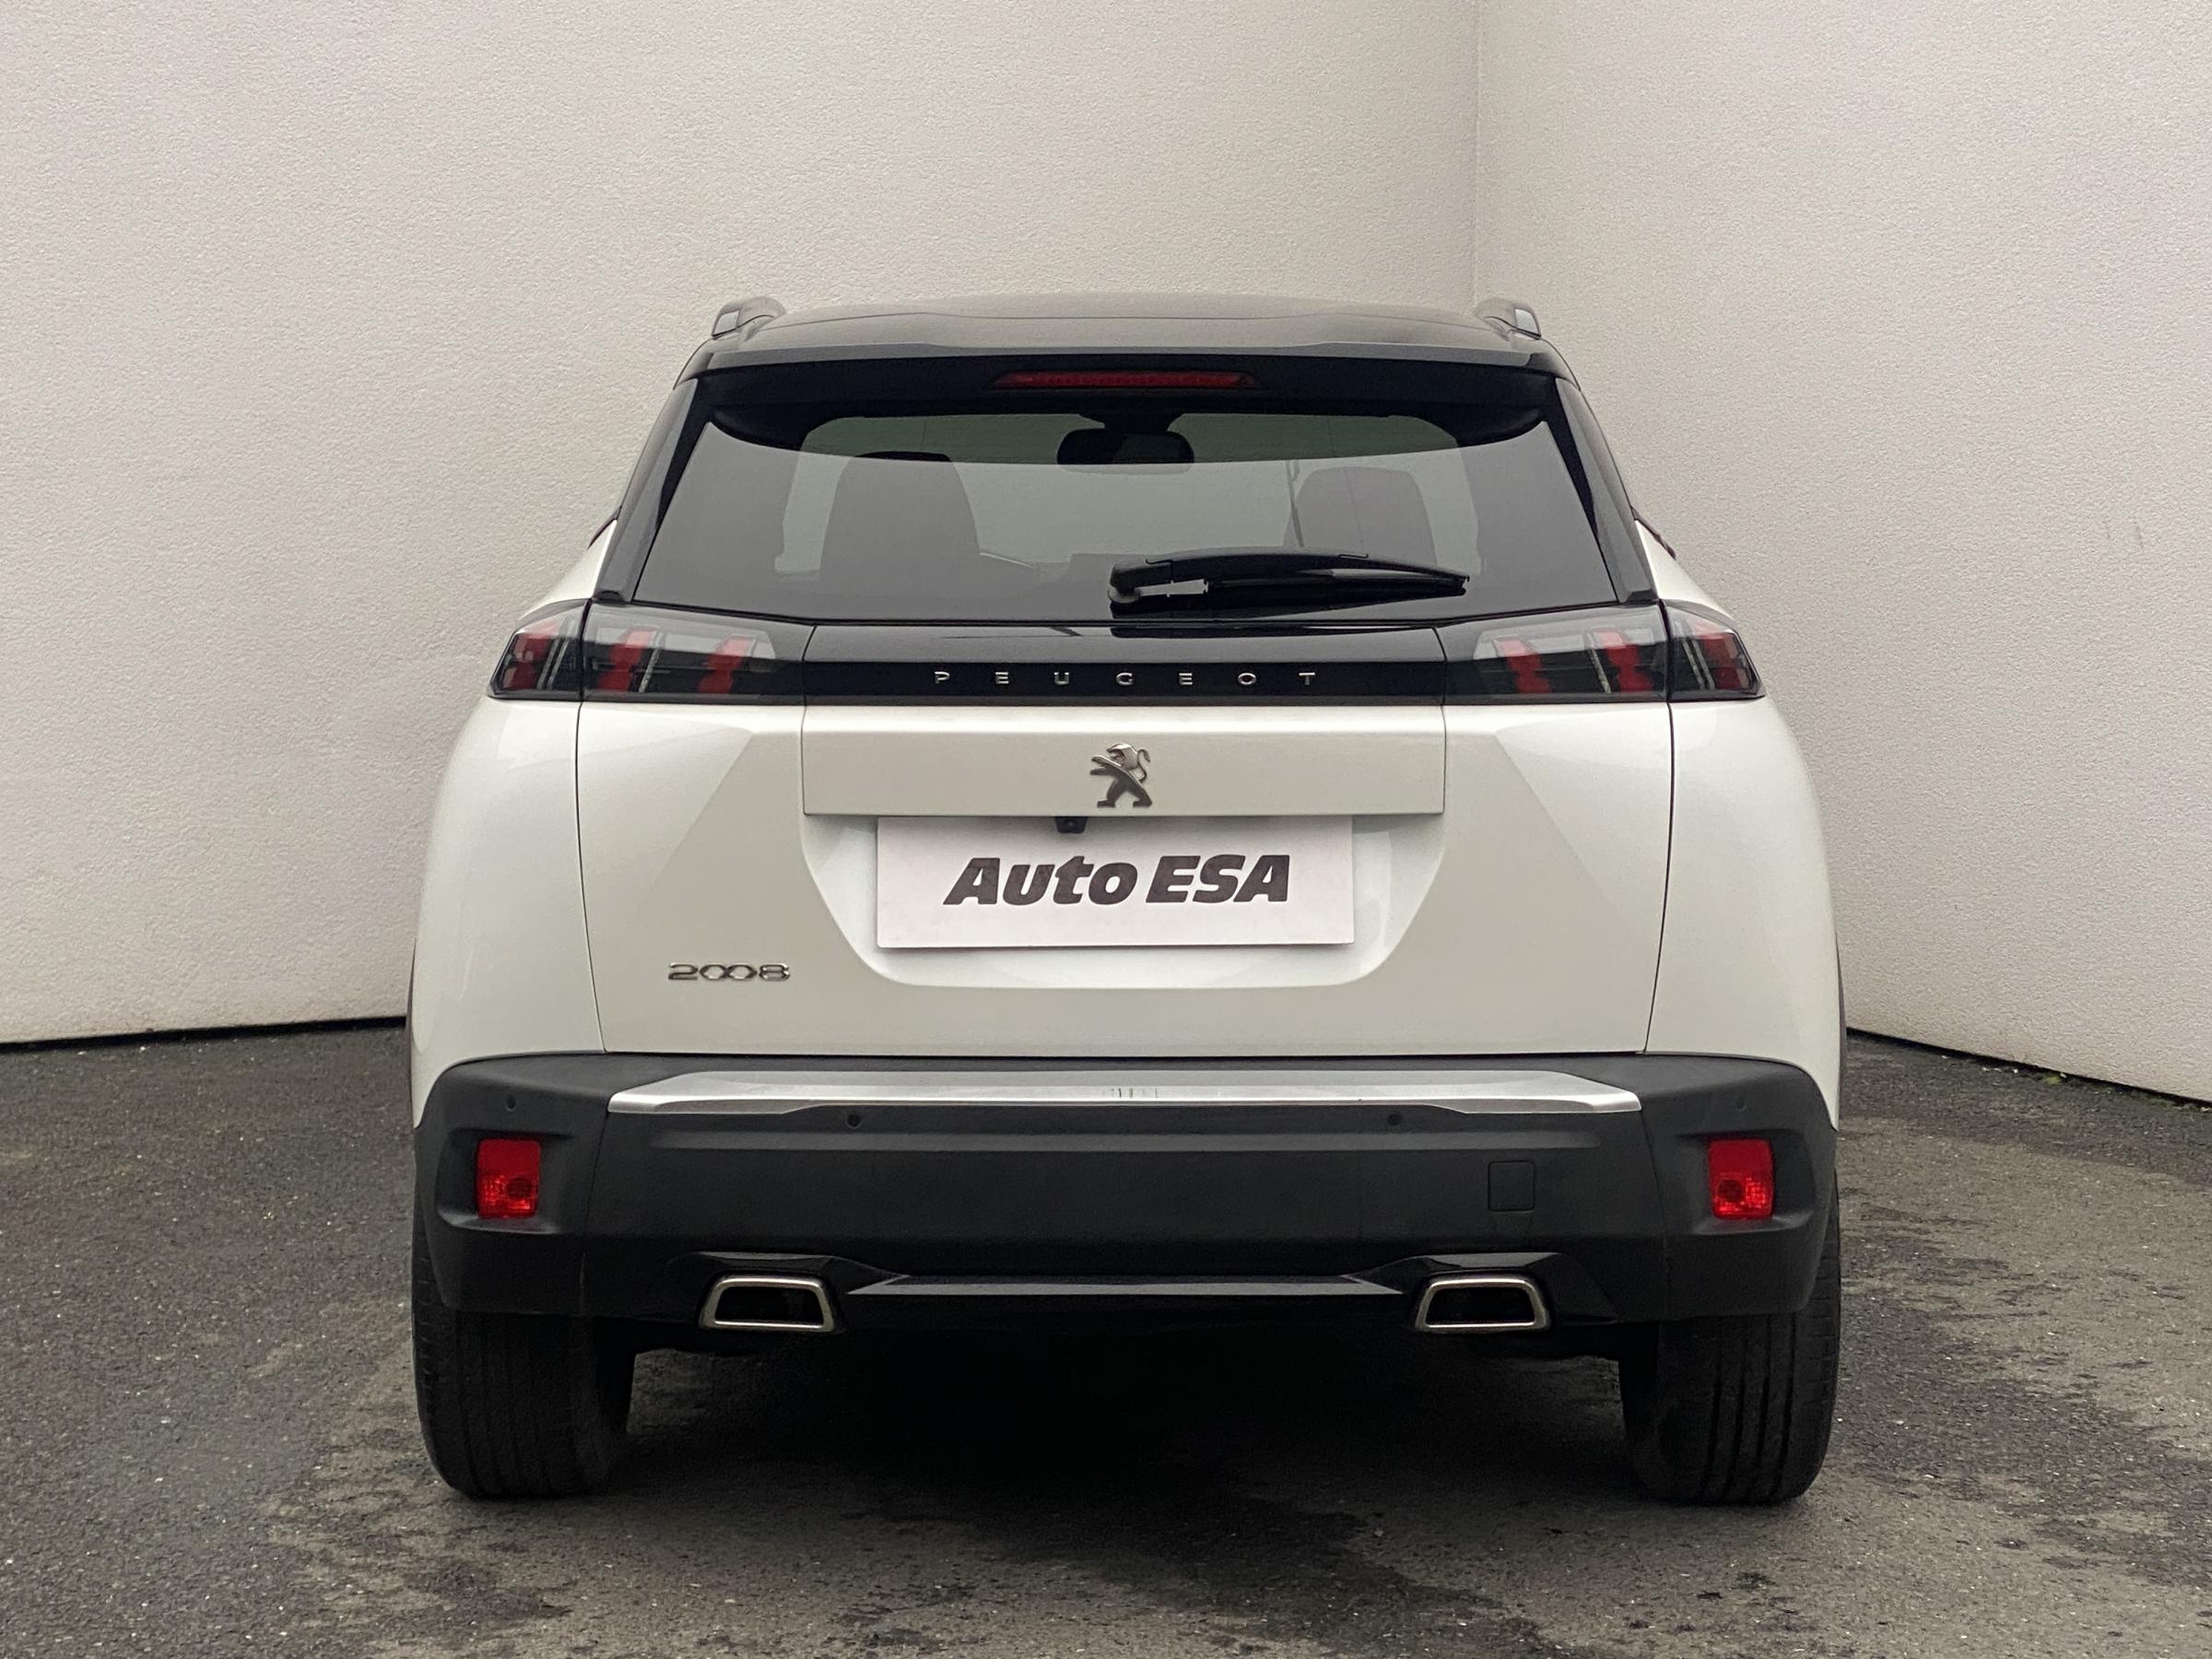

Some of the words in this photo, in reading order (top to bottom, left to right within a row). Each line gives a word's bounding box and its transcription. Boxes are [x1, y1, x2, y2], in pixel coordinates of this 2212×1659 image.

[934, 670, 1317, 687] PEUGEOT
[942, 854, 1138, 906] Auto
[1145, 853, 1290, 903] ESA
[667, 962, 791, 982] 2008
